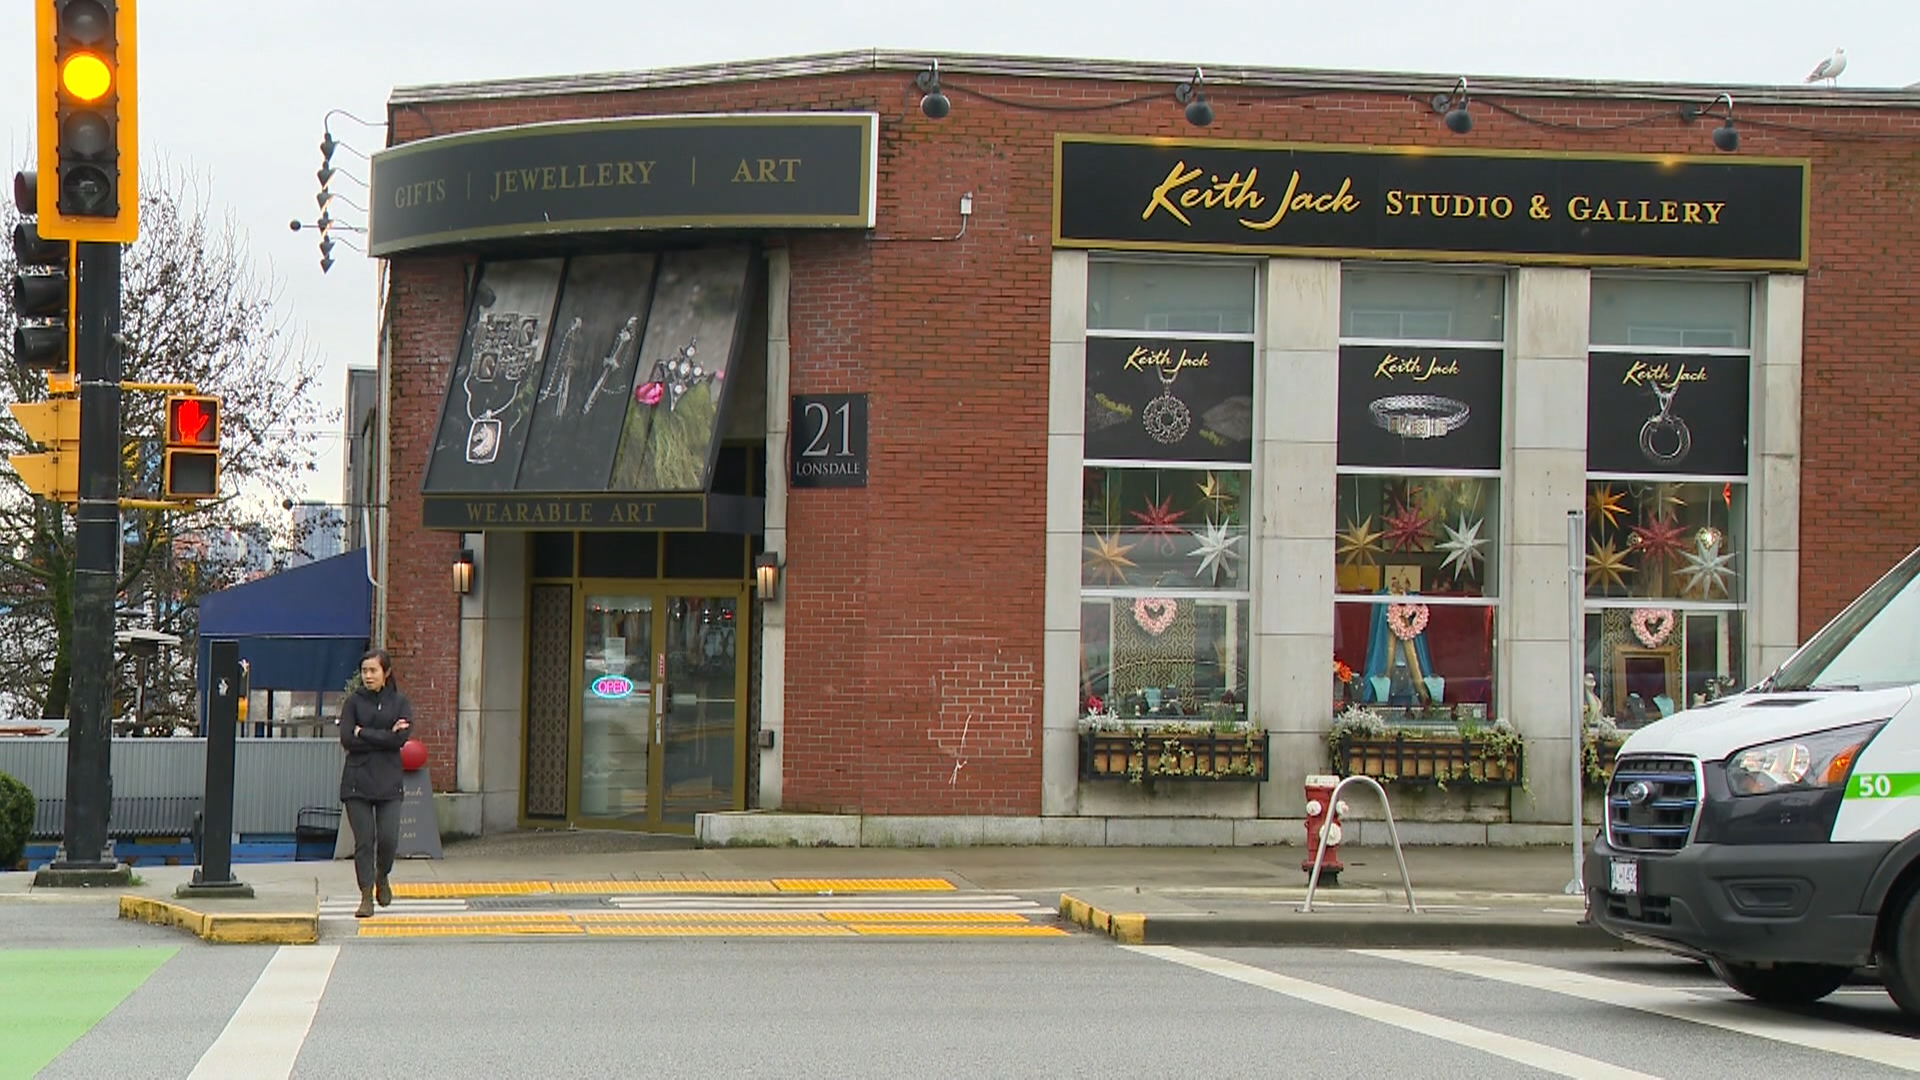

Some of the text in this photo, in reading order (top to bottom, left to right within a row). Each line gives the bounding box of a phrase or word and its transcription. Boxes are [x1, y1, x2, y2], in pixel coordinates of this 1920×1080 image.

[394, 158, 802, 208] GIFTS JEWELLERY ART
[1142, 160, 1726, 231] Keith Jack STUDIO & GALLERY
[1123, 344, 1212, 374] Keith Jack
[1374, 353, 1461, 382] Keith Jack
[1622, 360, 1709, 389] Keith Jack
[802, 402, 855, 456] 21
[796, 461, 860, 476] LONSDALE
[466, 502, 657, 523] WEARABLE ART
[597, 679, 628, 695] OPEN
[1859, 774, 1891, 797] 50
